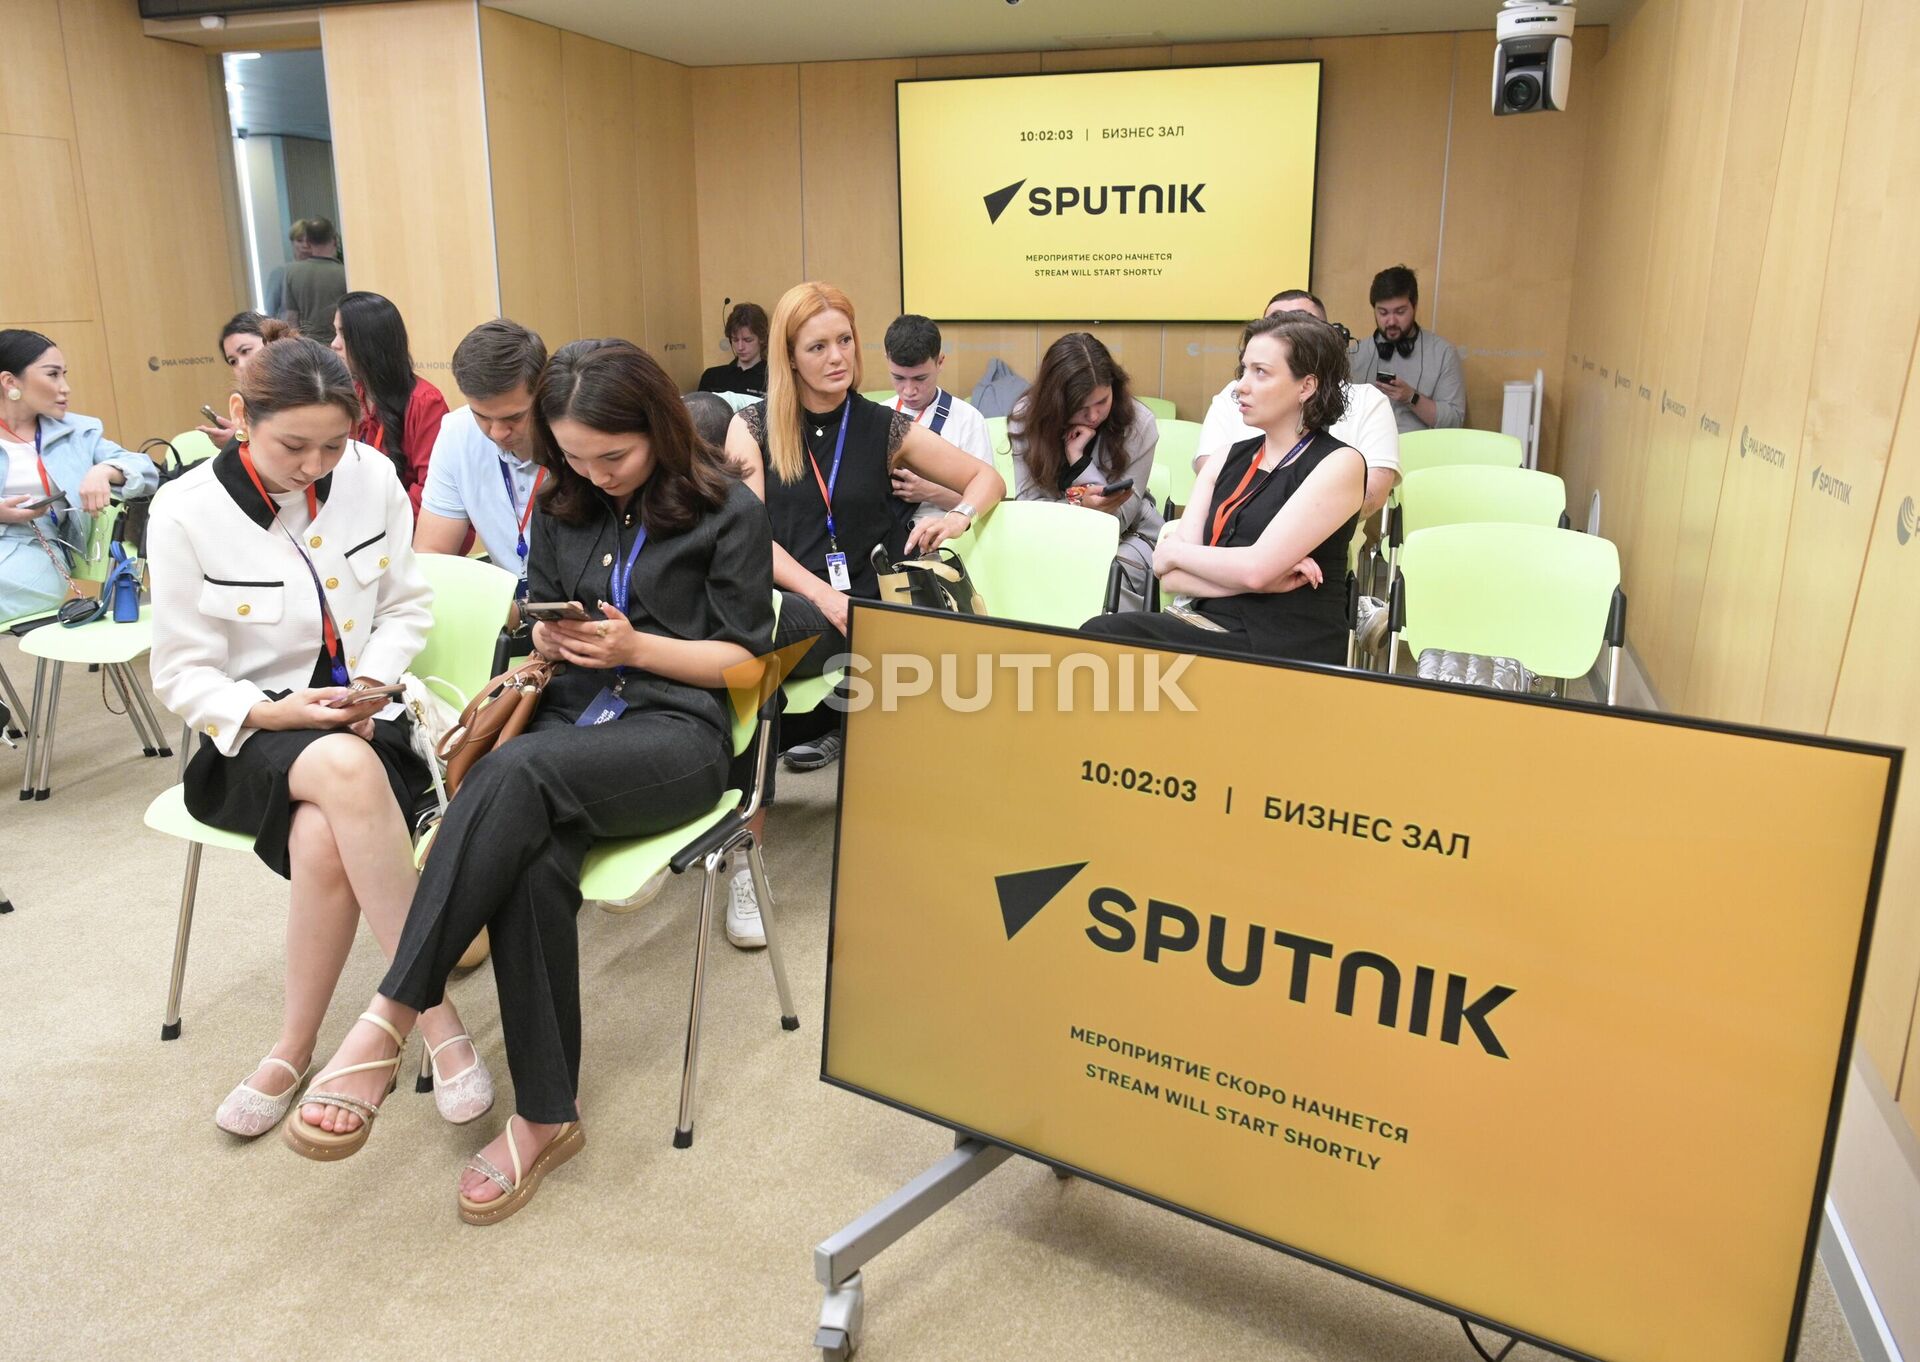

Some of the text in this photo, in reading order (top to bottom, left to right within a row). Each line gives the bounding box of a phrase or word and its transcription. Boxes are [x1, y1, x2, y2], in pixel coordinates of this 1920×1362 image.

[1020, 125, 1185, 142] 10:02:03 БИЗНЕС ЗАЛ
[1028, 183, 1206, 217] SPUTNIK
[1025, 252, 1173, 262] МЕРОПРИЯТИЕ СКОРО НАЧНЕТСЯ
[1034, 268, 1163, 277] STREAM WILL START SHORTLY
[161, 356, 215, 367] РИА НОВОСТИ
[1747, 437, 1786, 469] РИА НОВОСТИ
[1818, 471, 1853, 505] SPUTNIK
[1080, 759, 1471, 860] 10:02:03 БИЗНЕС ЗАЛ
[1085, 887, 1518, 1060] SPUTNIK
[1070, 1025, 1409, 1145] МЕРОПРИЯТИЕ СКОРО НАЧНЕТСЯ
[1086, 1063, 1382, 1171] STREAM WILL START SHORTLY
